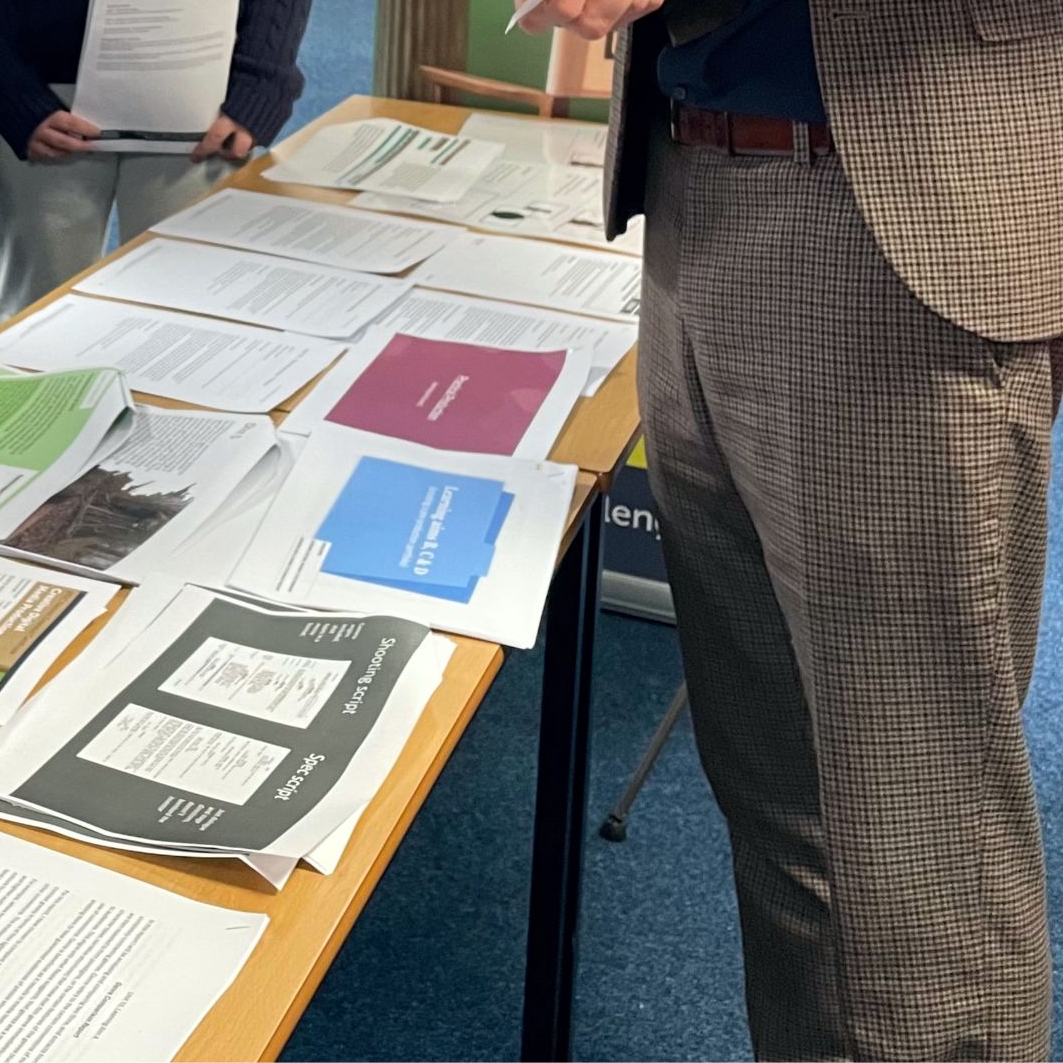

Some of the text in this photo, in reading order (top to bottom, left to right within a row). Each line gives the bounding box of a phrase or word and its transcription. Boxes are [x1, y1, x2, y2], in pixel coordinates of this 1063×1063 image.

[342, 637, 396, 715] Shooting script
[274, 753, 325, 801] Spec script
